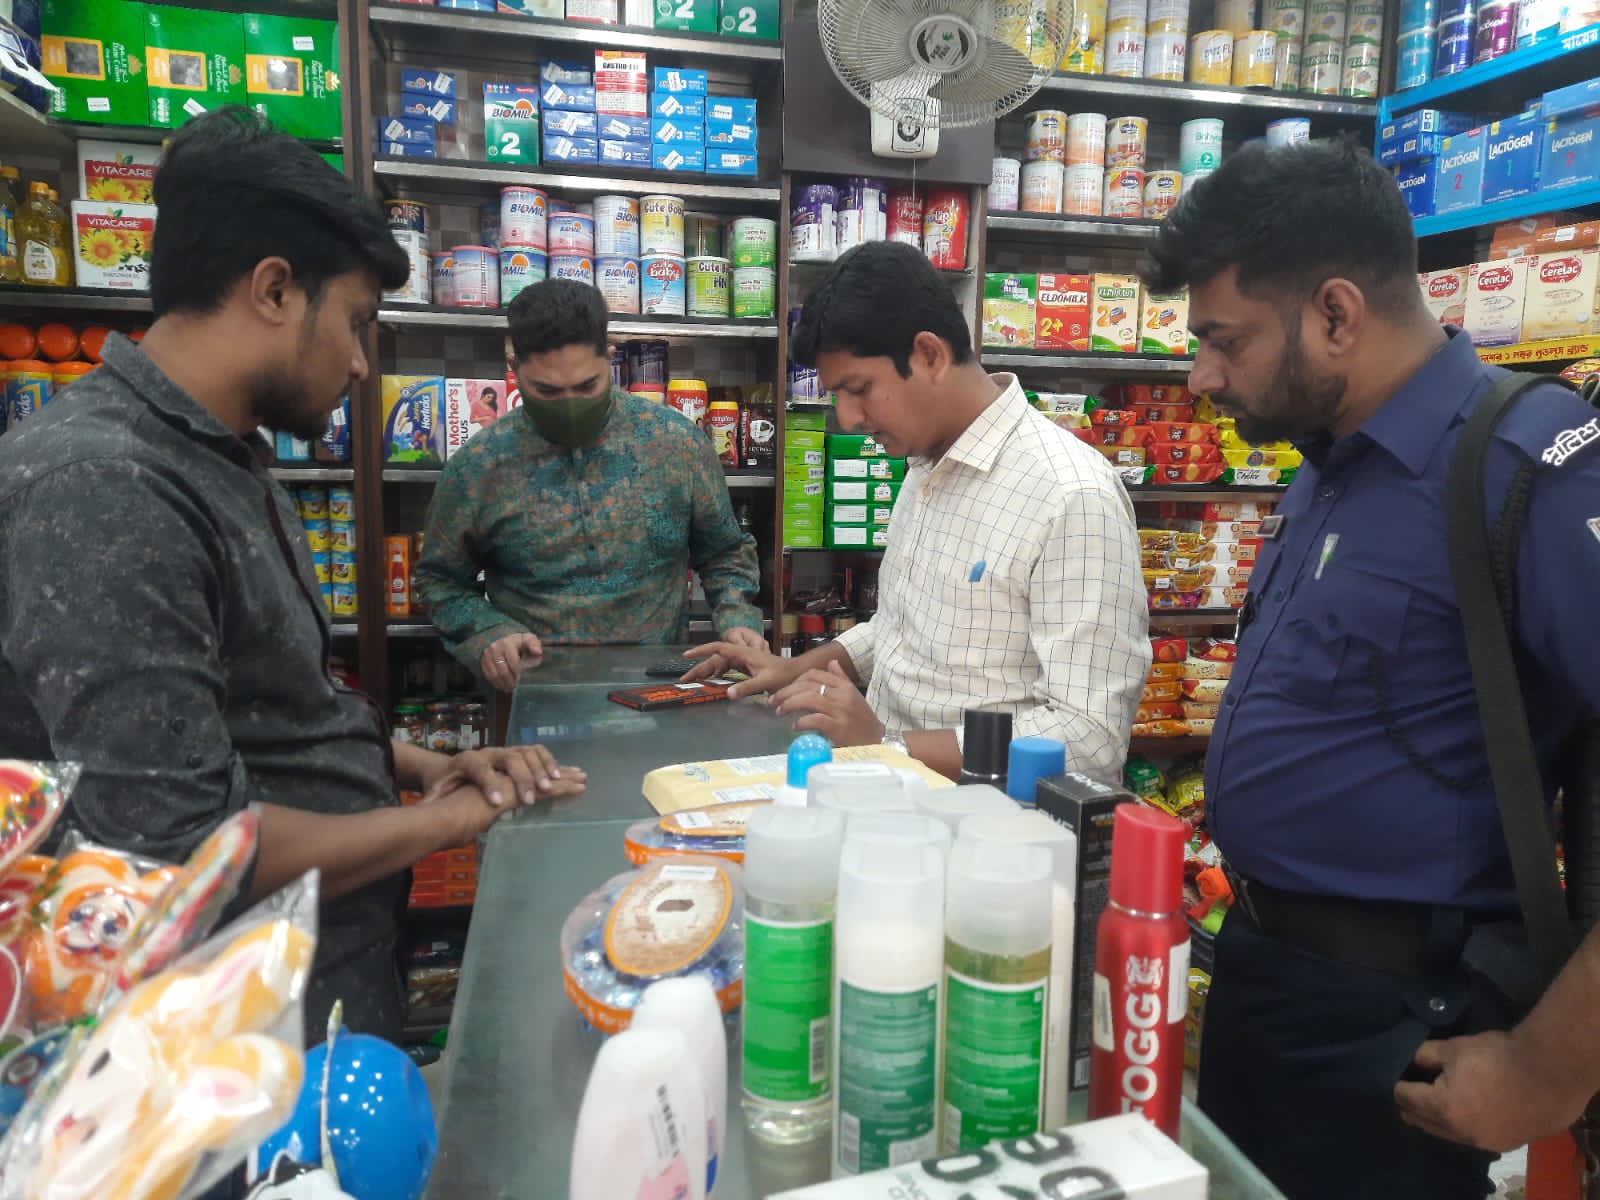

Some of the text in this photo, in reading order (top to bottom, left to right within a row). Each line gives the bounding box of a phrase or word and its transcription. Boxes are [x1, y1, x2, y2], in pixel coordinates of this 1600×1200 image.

[738, 7, 757, 33] 2
[492, 107, 530, 119] BIOMIL
[501, 132, 521, 155] 2
[1489, 131, 1534, 160] LACTOGEN
[1551, 129, 1593, 153] LACTOGEN
[1441, 146, 1481, 174] LACTOGEN
[92, 165, 153, 178] VITACARE
[1453, 173, 1463, 190] 2
[511, 203, 544, 217] BIOMIL
[87, 218, 141, 228] VITACARE
[604, 267, 637, 278] BIOMIL
[1479, 273, 1510, 286] Cerelac
[1542, 264, 1579, 277] Cerelac
[1430, 281, 1457, 291] Cerelac
[1096, 306, 1109, 327] 2
[1146, 307, 1160, 329] 2
[1039, 317, 1064, 337] 2+
[421, 395, 433, 430] Horlicks
[448, 388, 460, 446] Mother's
[1541, 417, 1600, 467] পুলিশ
